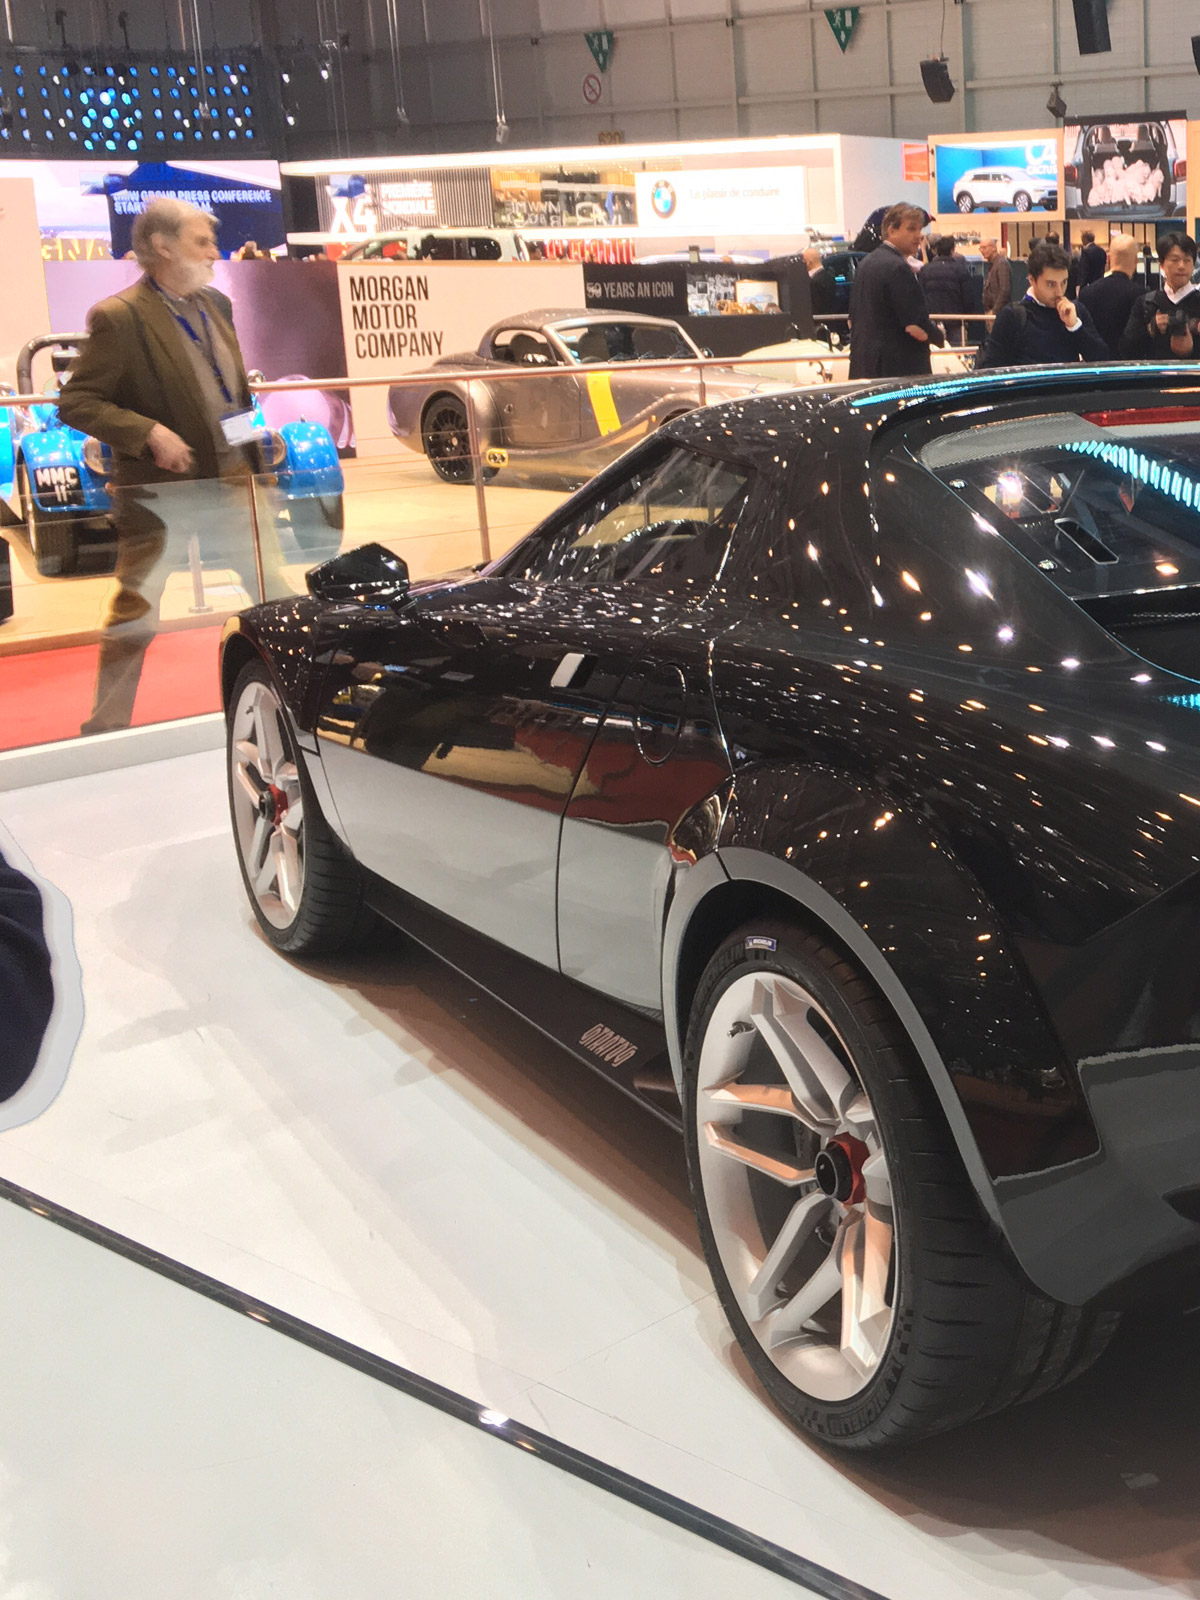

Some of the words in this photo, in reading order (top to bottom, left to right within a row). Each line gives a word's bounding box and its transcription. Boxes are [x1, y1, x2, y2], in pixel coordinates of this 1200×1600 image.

[177, 190, 210, 202] PRESS
[211, 189, 271, 203] CONFERENCE
[325, 184, 378, 233] X4
[349, 275, 429, 301] MORGAN
[603, 281, 635, 298] YEARS
[637, 281, 651, 298] AN
[652, 281, 675, 298] ICON
[352, 303, 418, 330] MOTOR
[355, 331, 443, 359] COMPANY
[36, 466, 78, 487] MMC
